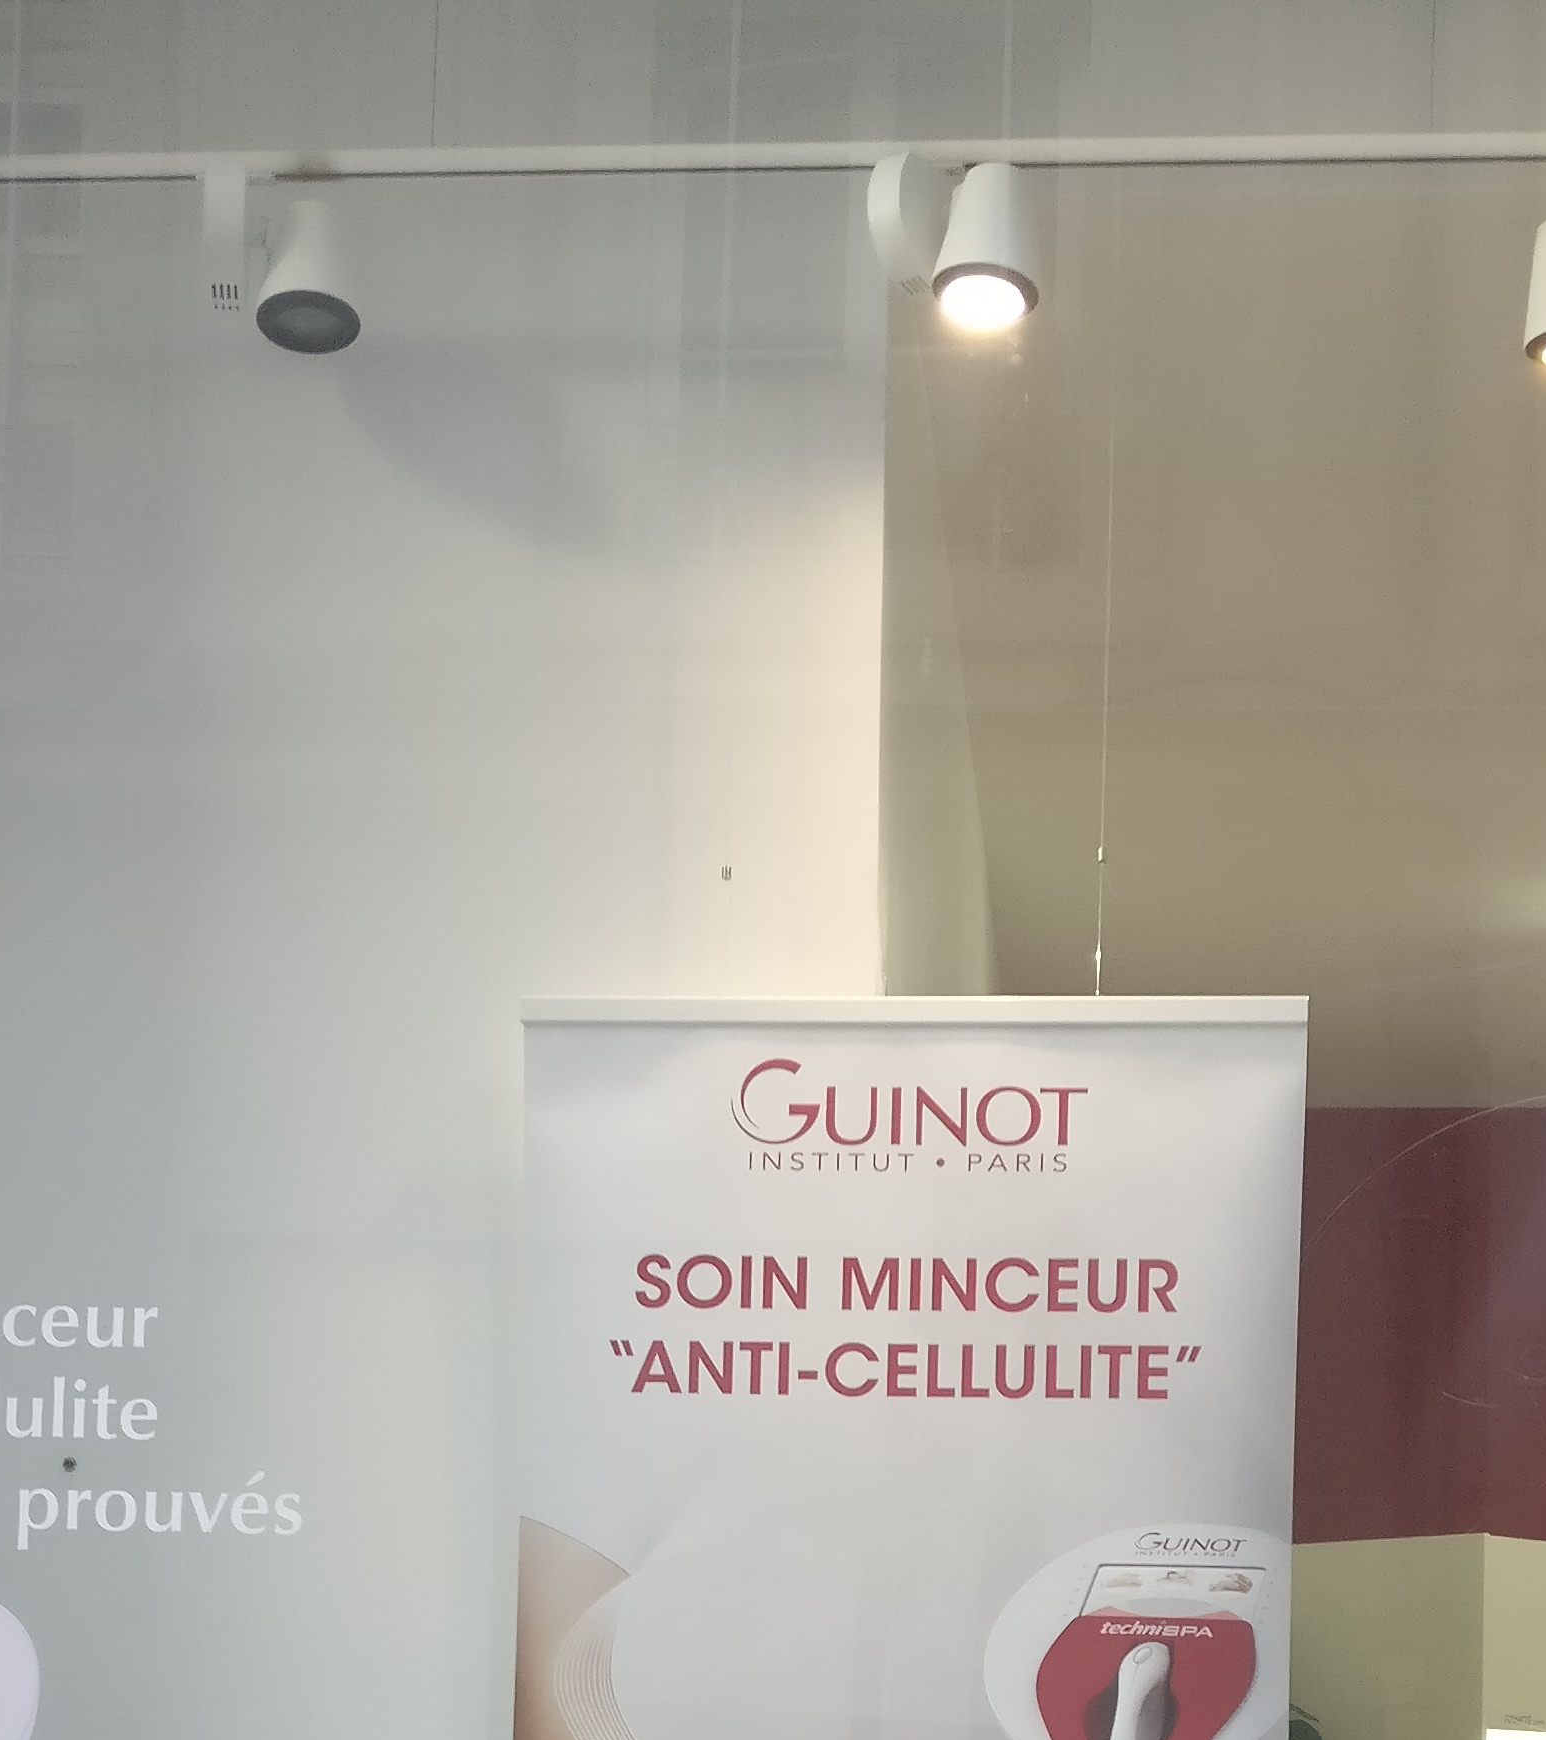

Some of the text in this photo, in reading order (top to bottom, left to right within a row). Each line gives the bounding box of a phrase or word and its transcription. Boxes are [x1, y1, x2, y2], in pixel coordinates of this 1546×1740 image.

[730, 1057, 1089, 1147] GUINOT
[747, 1151, 1069, 1174] INSTITUT PARIS
[634, 1252, 1180, 1315] SOIN MINCEUR
[609, 1338, 1203, 1401] "ANTI-CELLULITE"
[16, 1469, 304, 1550] prouvés
[1134, 1532, 1248, 1552] GUINOT
